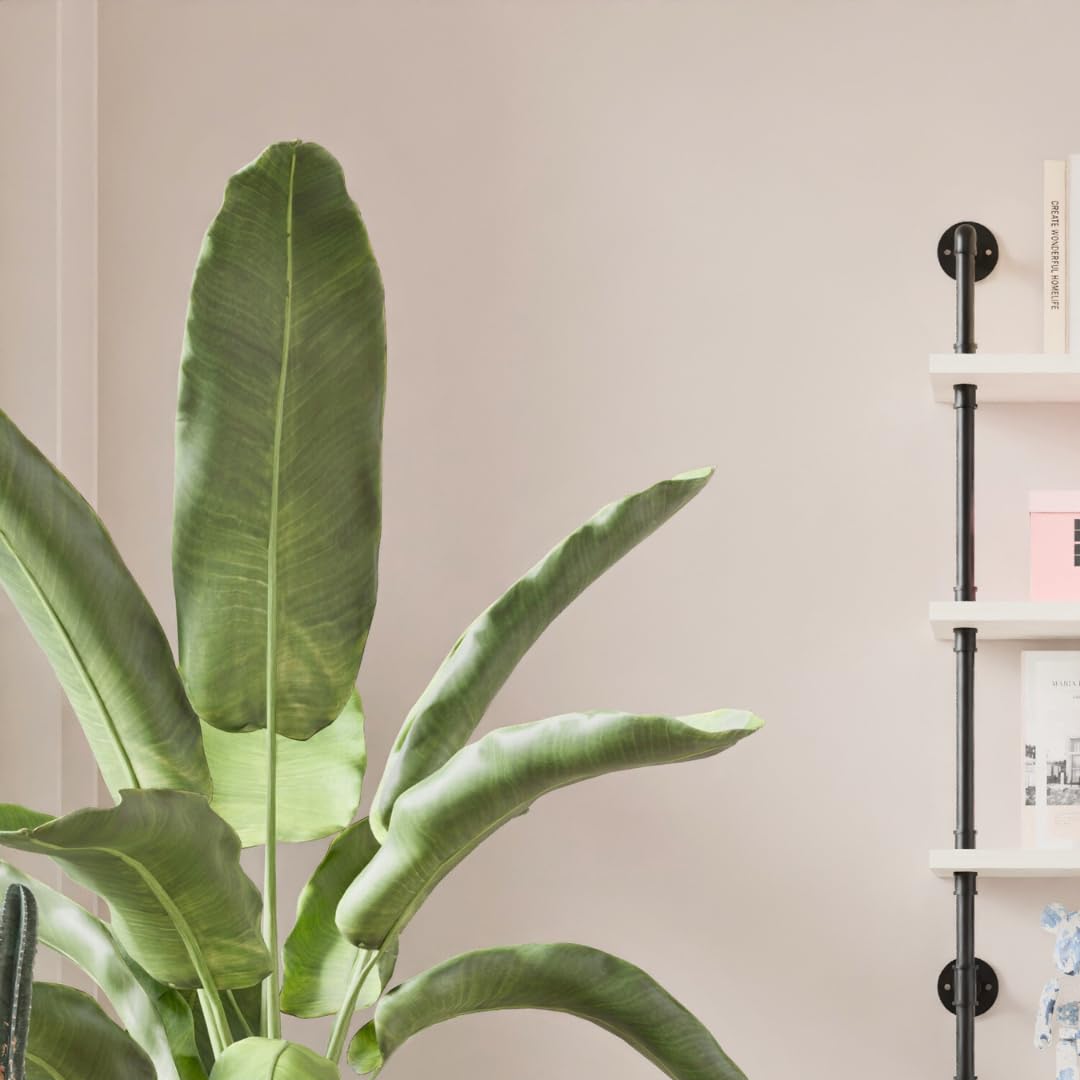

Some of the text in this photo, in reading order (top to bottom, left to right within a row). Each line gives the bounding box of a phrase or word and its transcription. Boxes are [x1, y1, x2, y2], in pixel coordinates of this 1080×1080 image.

[1050, 200, 1060, 310] CREATE WONDERFUL HOMELIFE
